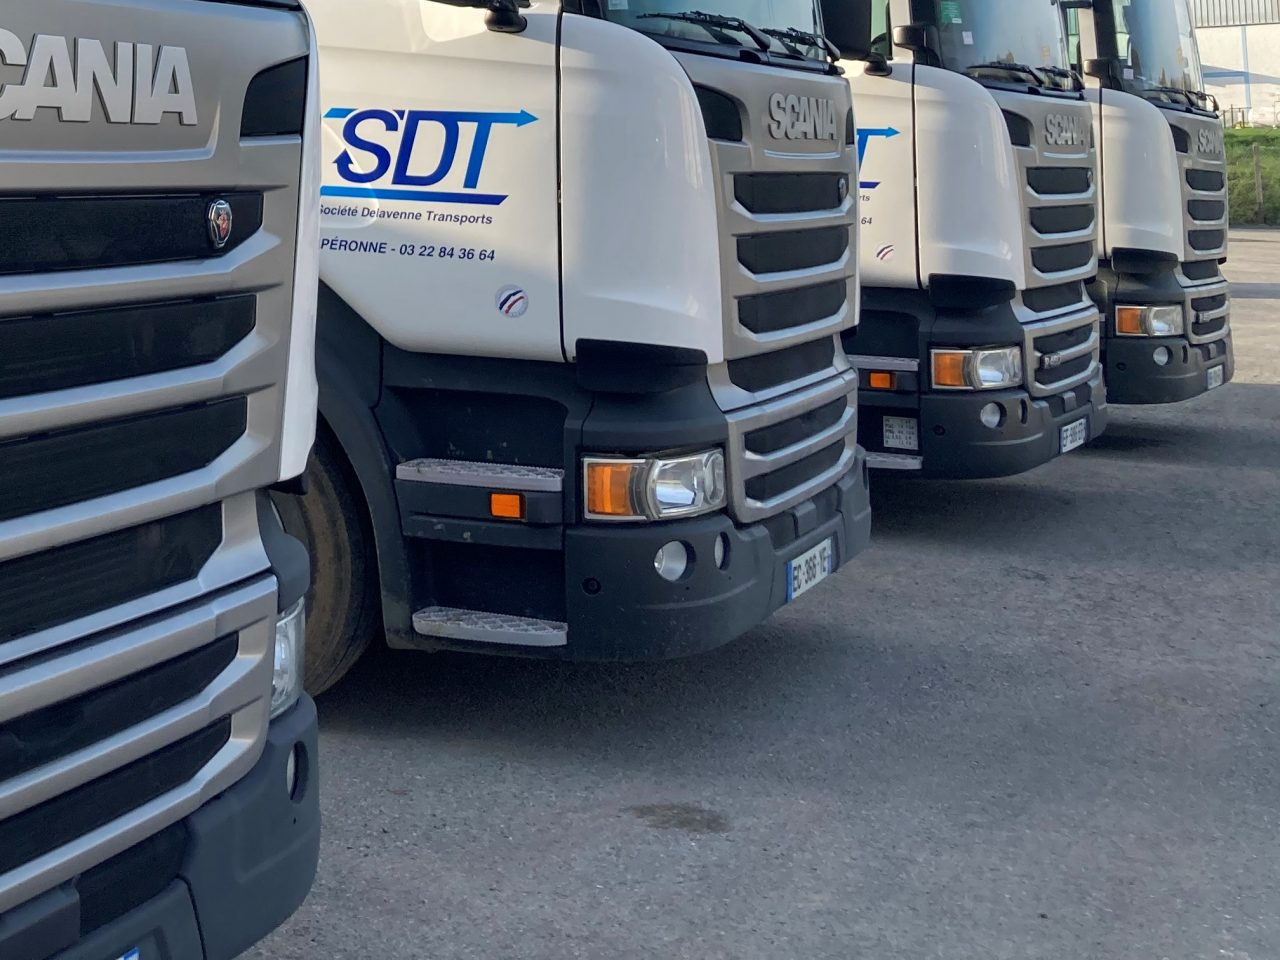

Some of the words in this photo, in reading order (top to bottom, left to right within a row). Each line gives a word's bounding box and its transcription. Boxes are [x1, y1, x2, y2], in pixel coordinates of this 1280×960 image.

[769, 92, 837, 140] SCANIA
[330, 109, 539, 189] SDT
[360, 206, 422, 221] Delavenne
[426, 210, 493, 225] Transports
[861, 216, 873, 225] 64
[321, 236, 387, 254] PÉRONNE
[399, 243, 415, 256] 03
[418, 244, 435, 258] 22
[438, 246, 455, 259] 84
[458, 247, 475, 261] 36
[478, 249, 495, 262] 64
